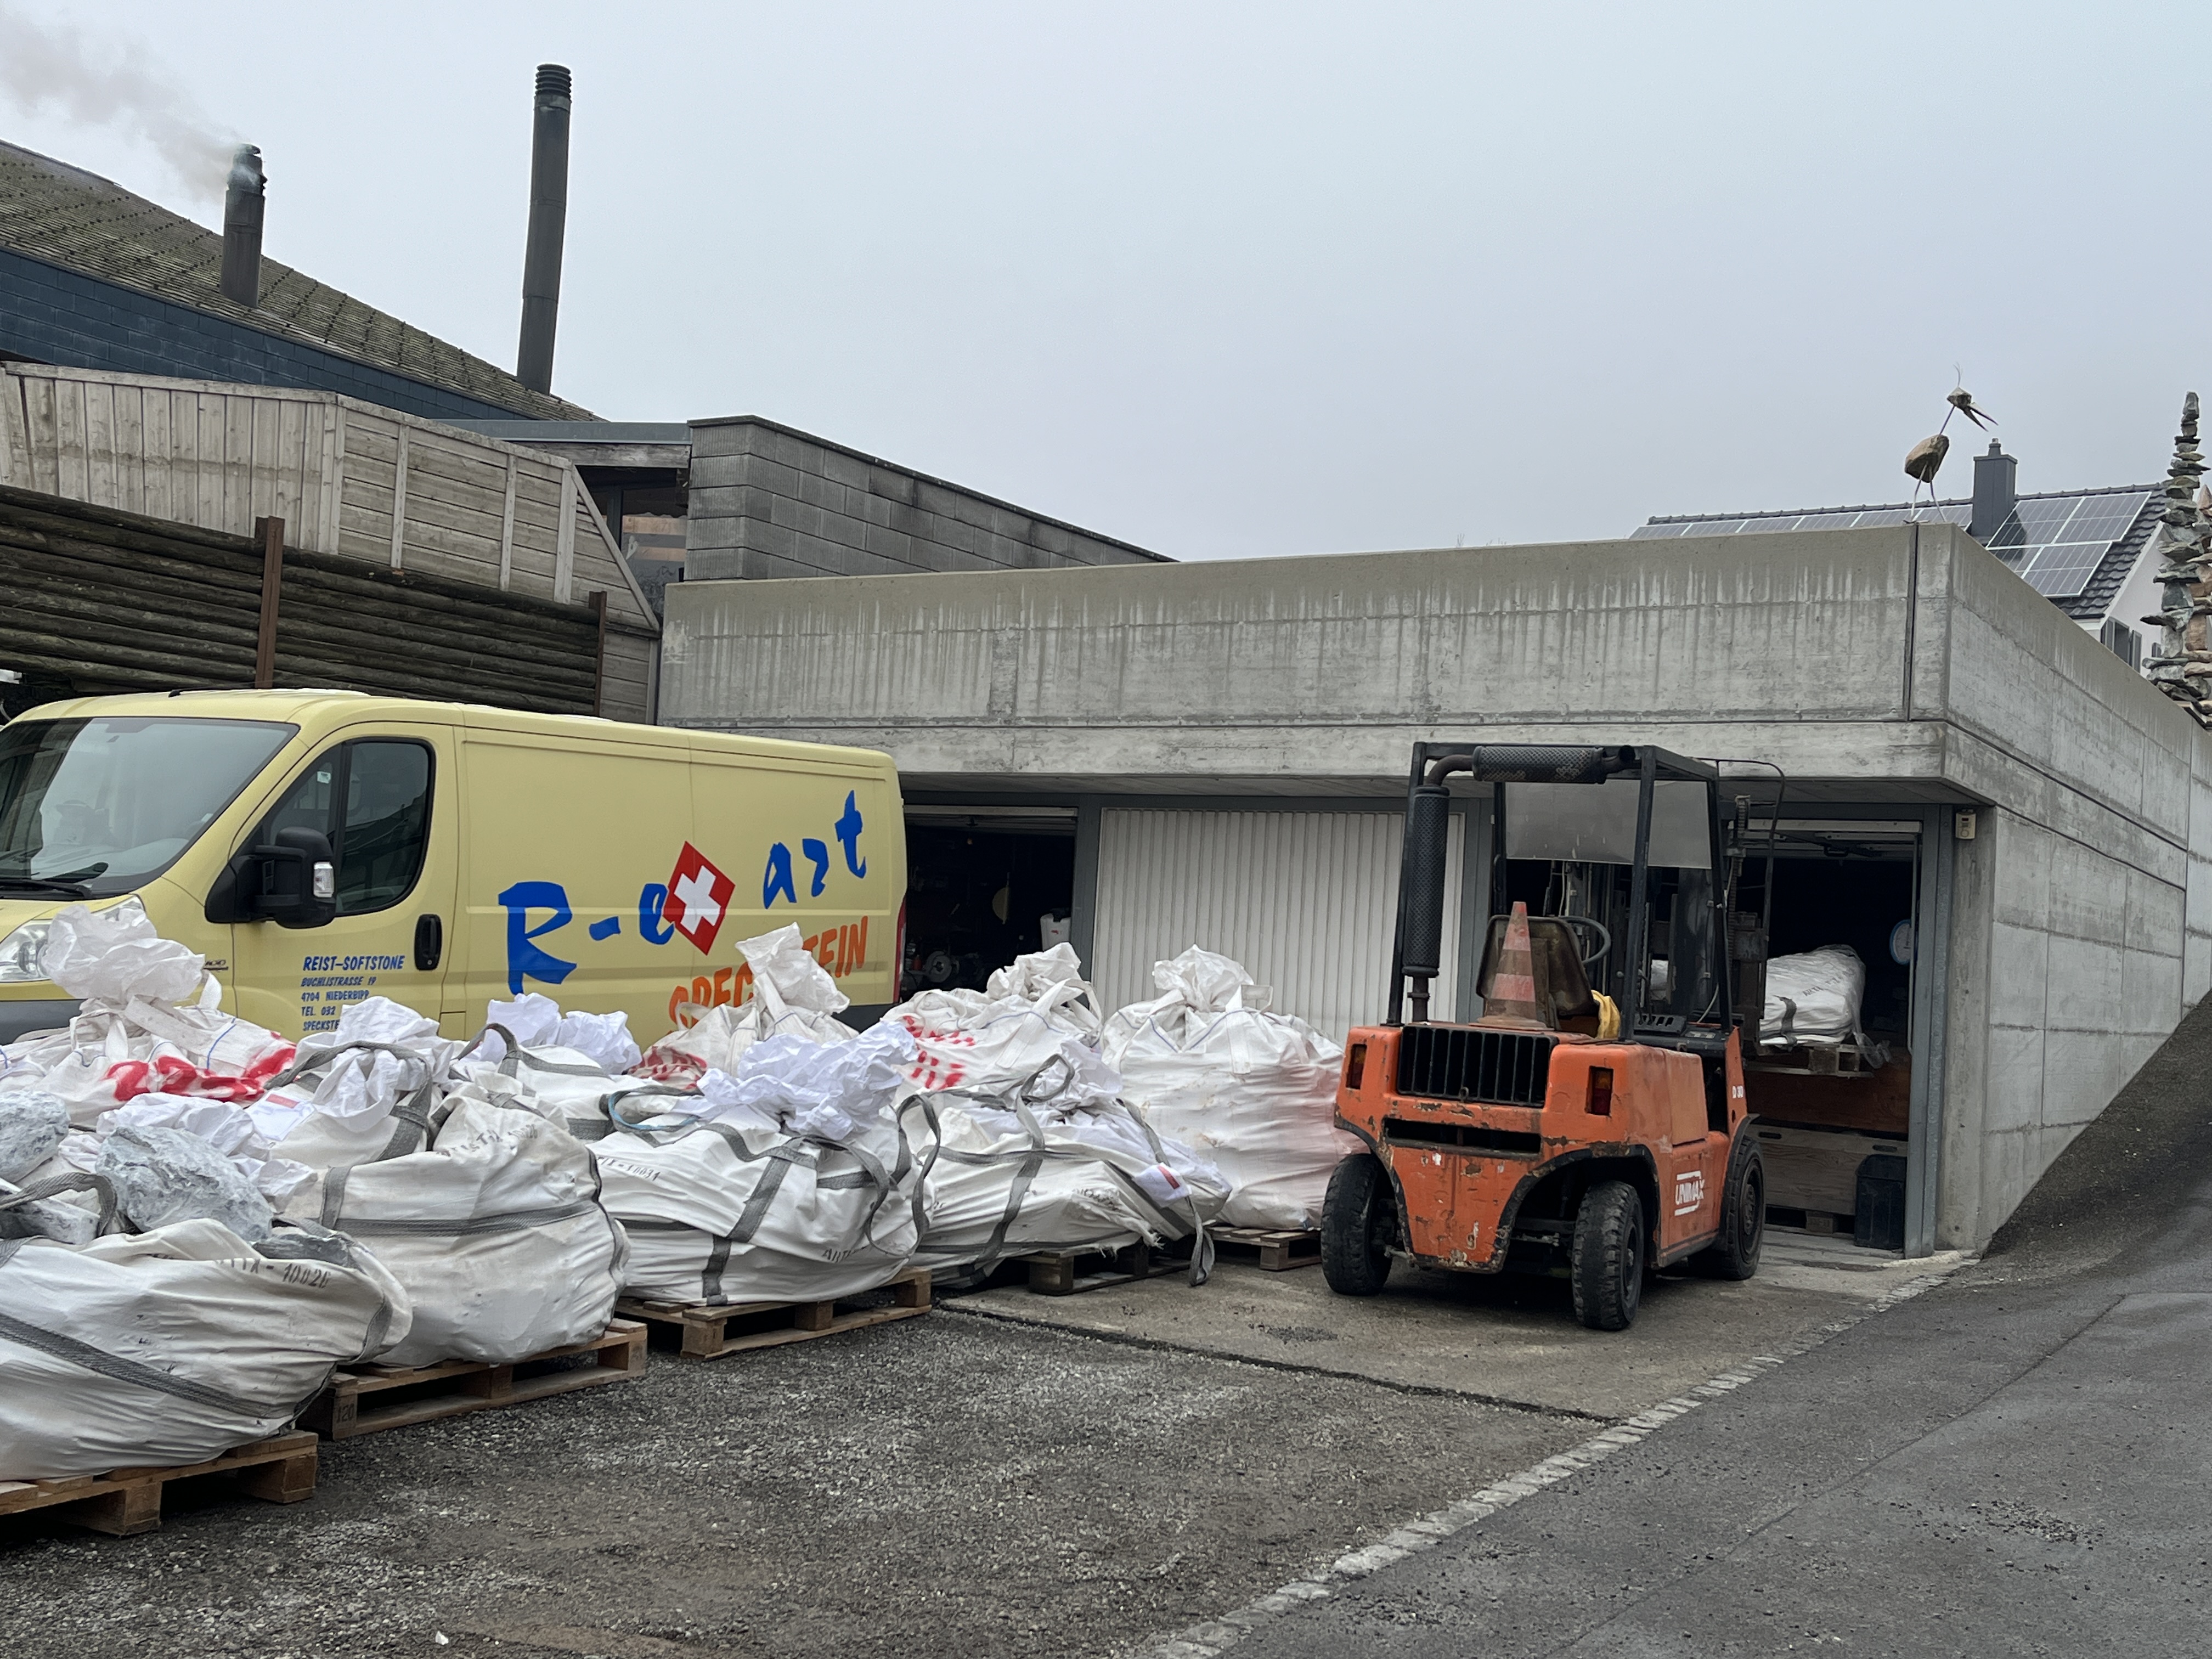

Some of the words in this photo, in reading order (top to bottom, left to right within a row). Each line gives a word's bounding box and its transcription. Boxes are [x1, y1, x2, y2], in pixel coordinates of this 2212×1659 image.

[303, 955, 405, 971] REIST-SOFTSTONE
[667, 916, 868, 1036] SPECEIN
[301, 992, 320, 1002] 4704
[326, 990, 369, 1001] NIEDERBIPP
[321, 1006, 336, 1016] 032
